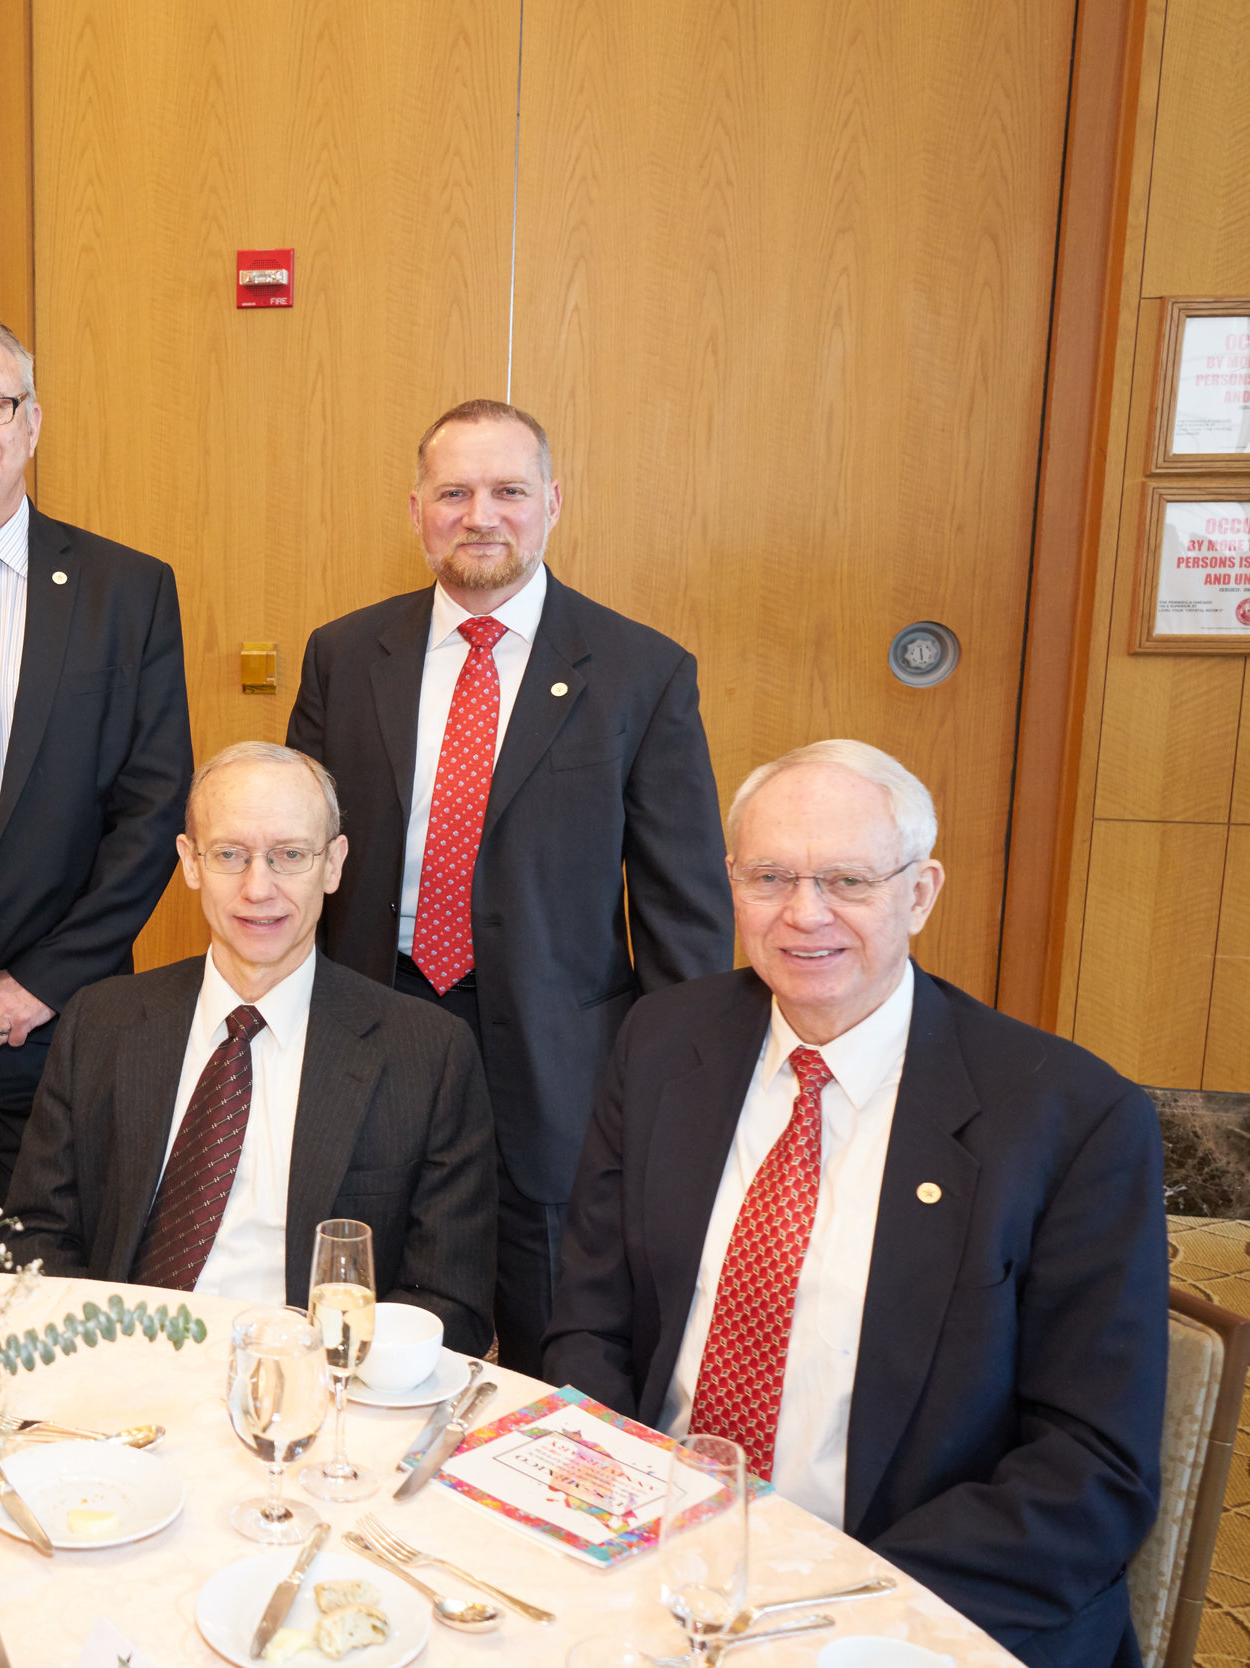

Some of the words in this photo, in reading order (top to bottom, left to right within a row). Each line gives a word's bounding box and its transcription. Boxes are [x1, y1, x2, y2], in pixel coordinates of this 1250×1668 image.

[270, 297, 288, 305] FIRE
[1224, 390, 1250, 404] AND
[1187, 539, 1204, 552] BY
[1206, 539, 1244, 552] MORE
[1176, 556, 1236, 569] PERSONS
[1204, 573, 1231, 586] AND
